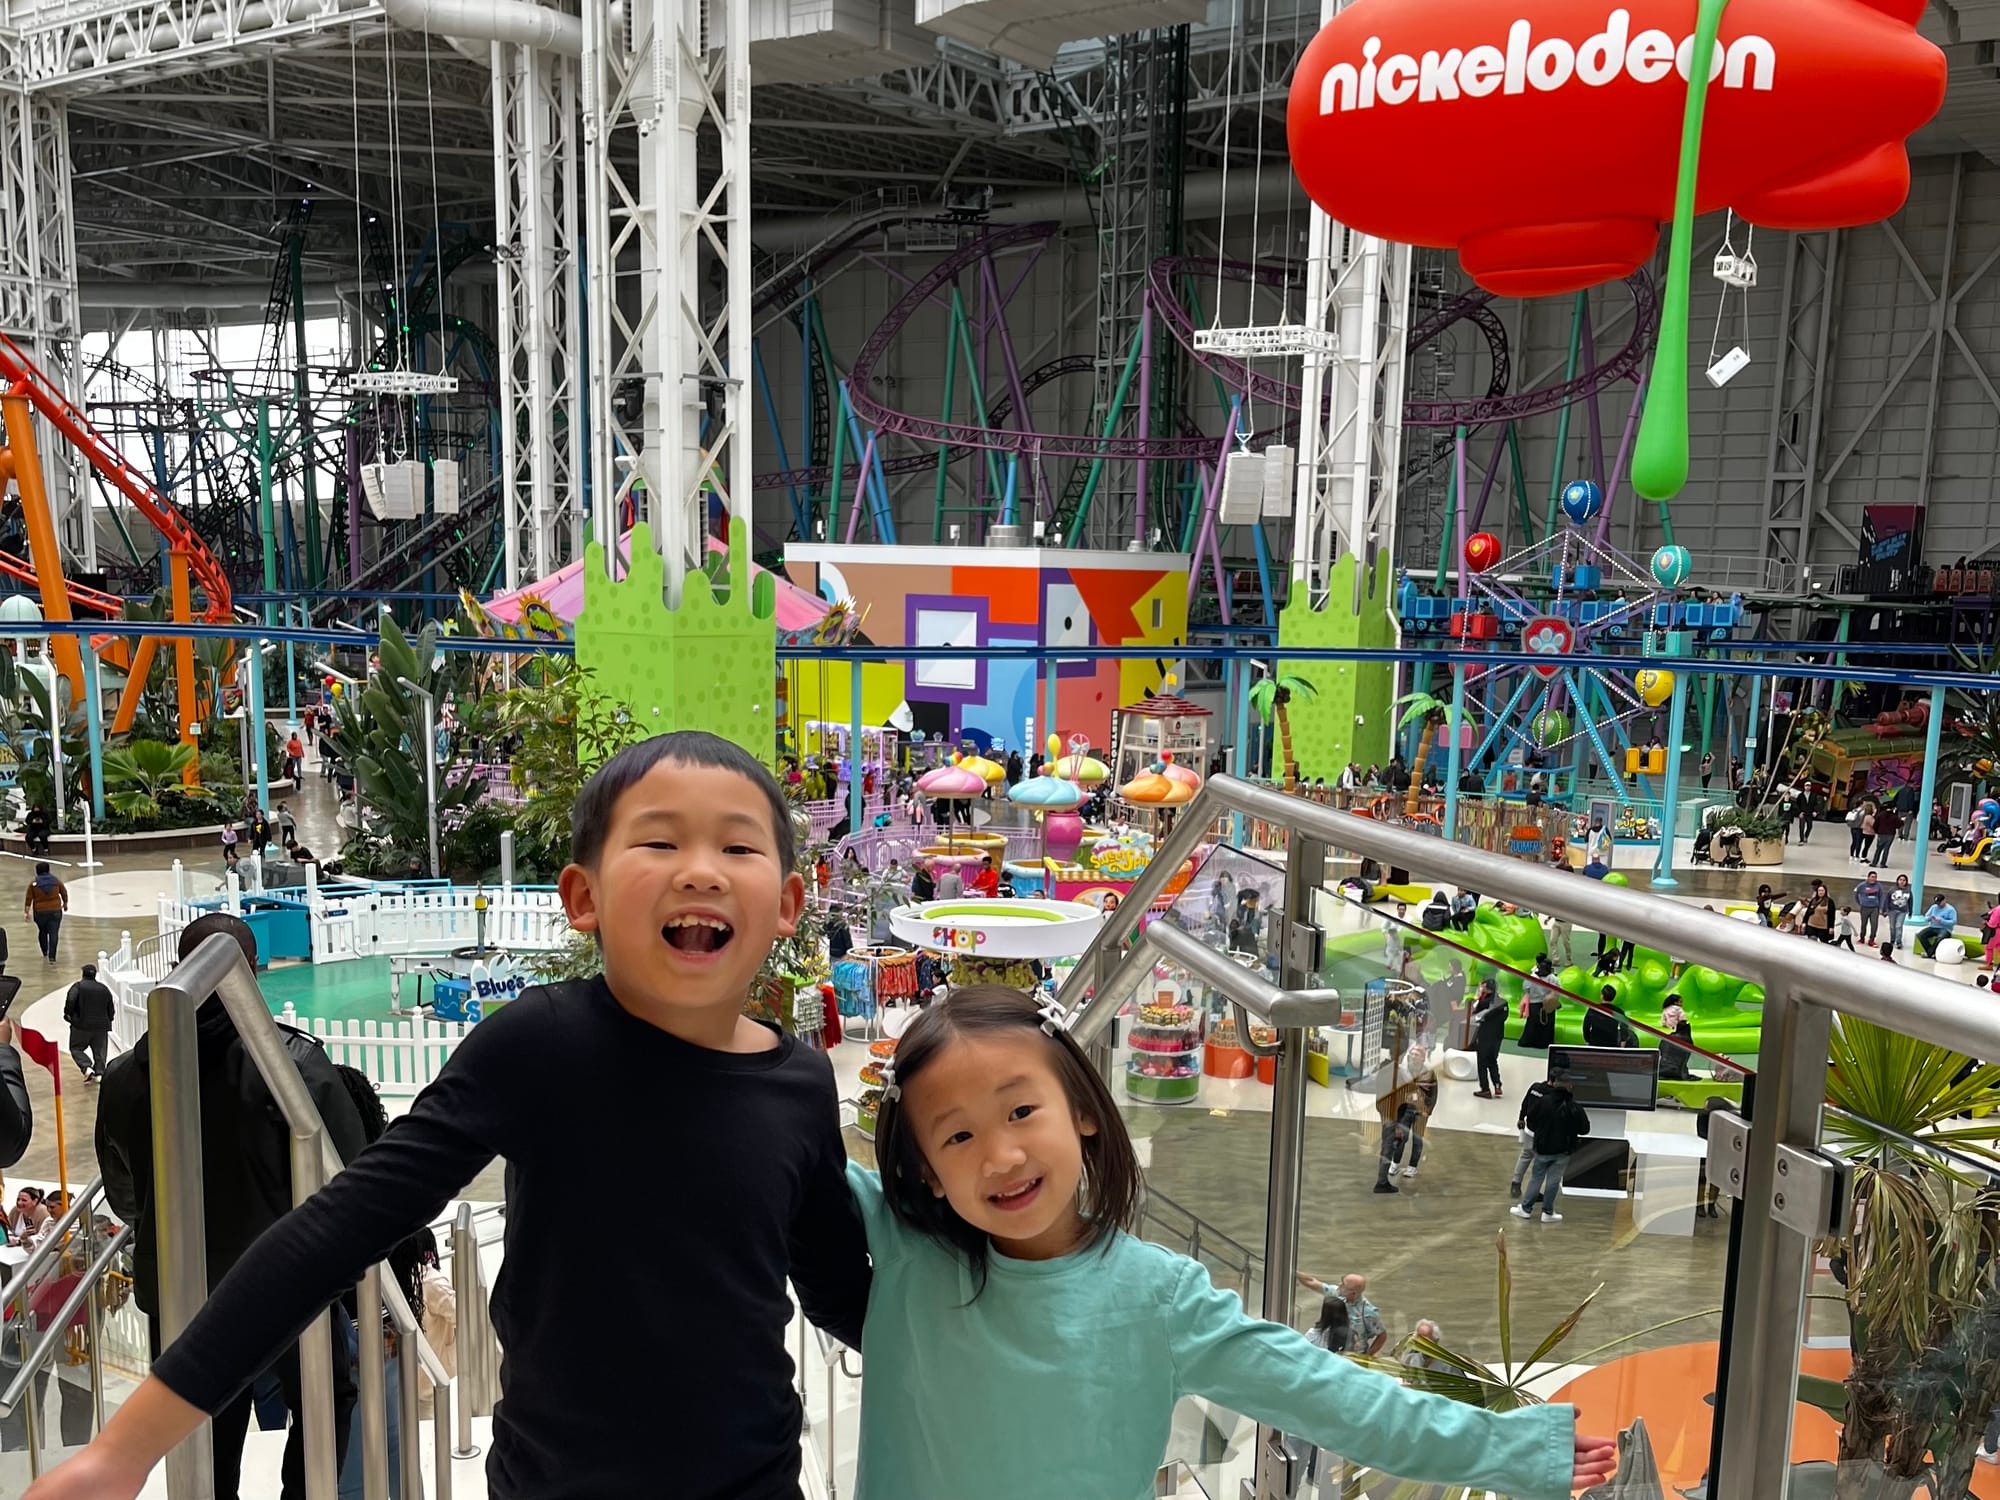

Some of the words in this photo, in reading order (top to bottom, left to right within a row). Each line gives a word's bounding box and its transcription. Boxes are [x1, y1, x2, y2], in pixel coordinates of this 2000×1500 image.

[1320, 8, 1776, 116] nickelodeon
[933, 926, 986, 953] SHOP
[476, 975, 525, 998] Blue's
